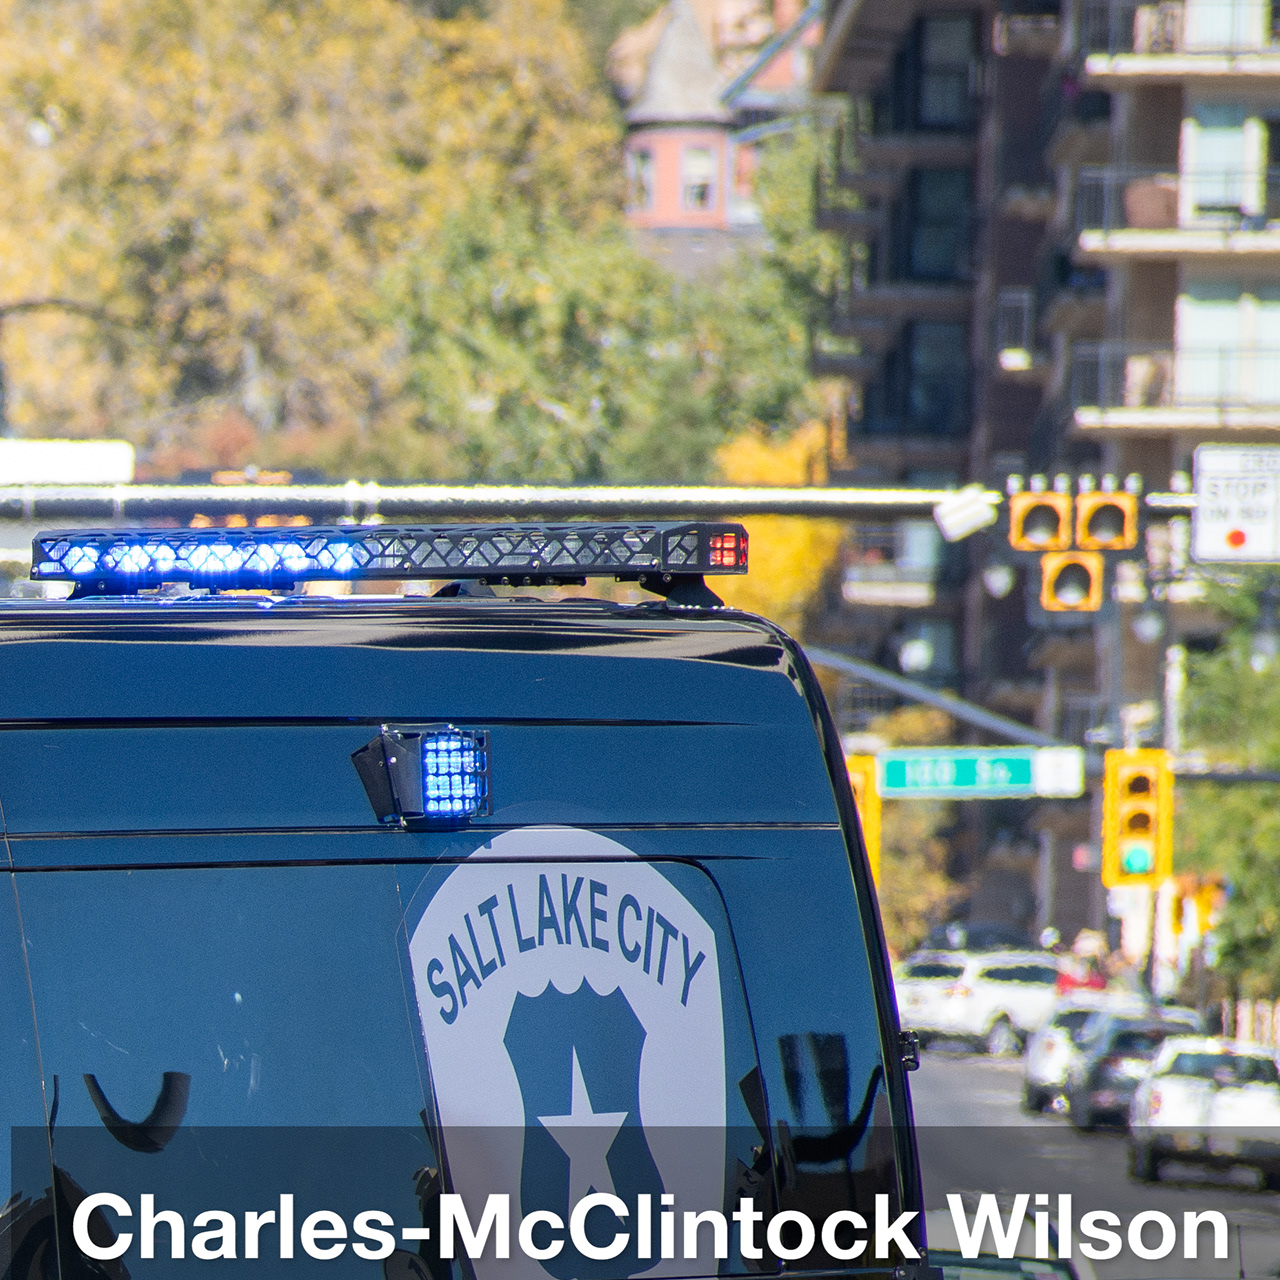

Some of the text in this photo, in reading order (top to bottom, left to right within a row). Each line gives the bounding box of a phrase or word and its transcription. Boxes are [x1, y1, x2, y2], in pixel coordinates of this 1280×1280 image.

[426, 872, 706, 1025] SALT LAKE CITY
